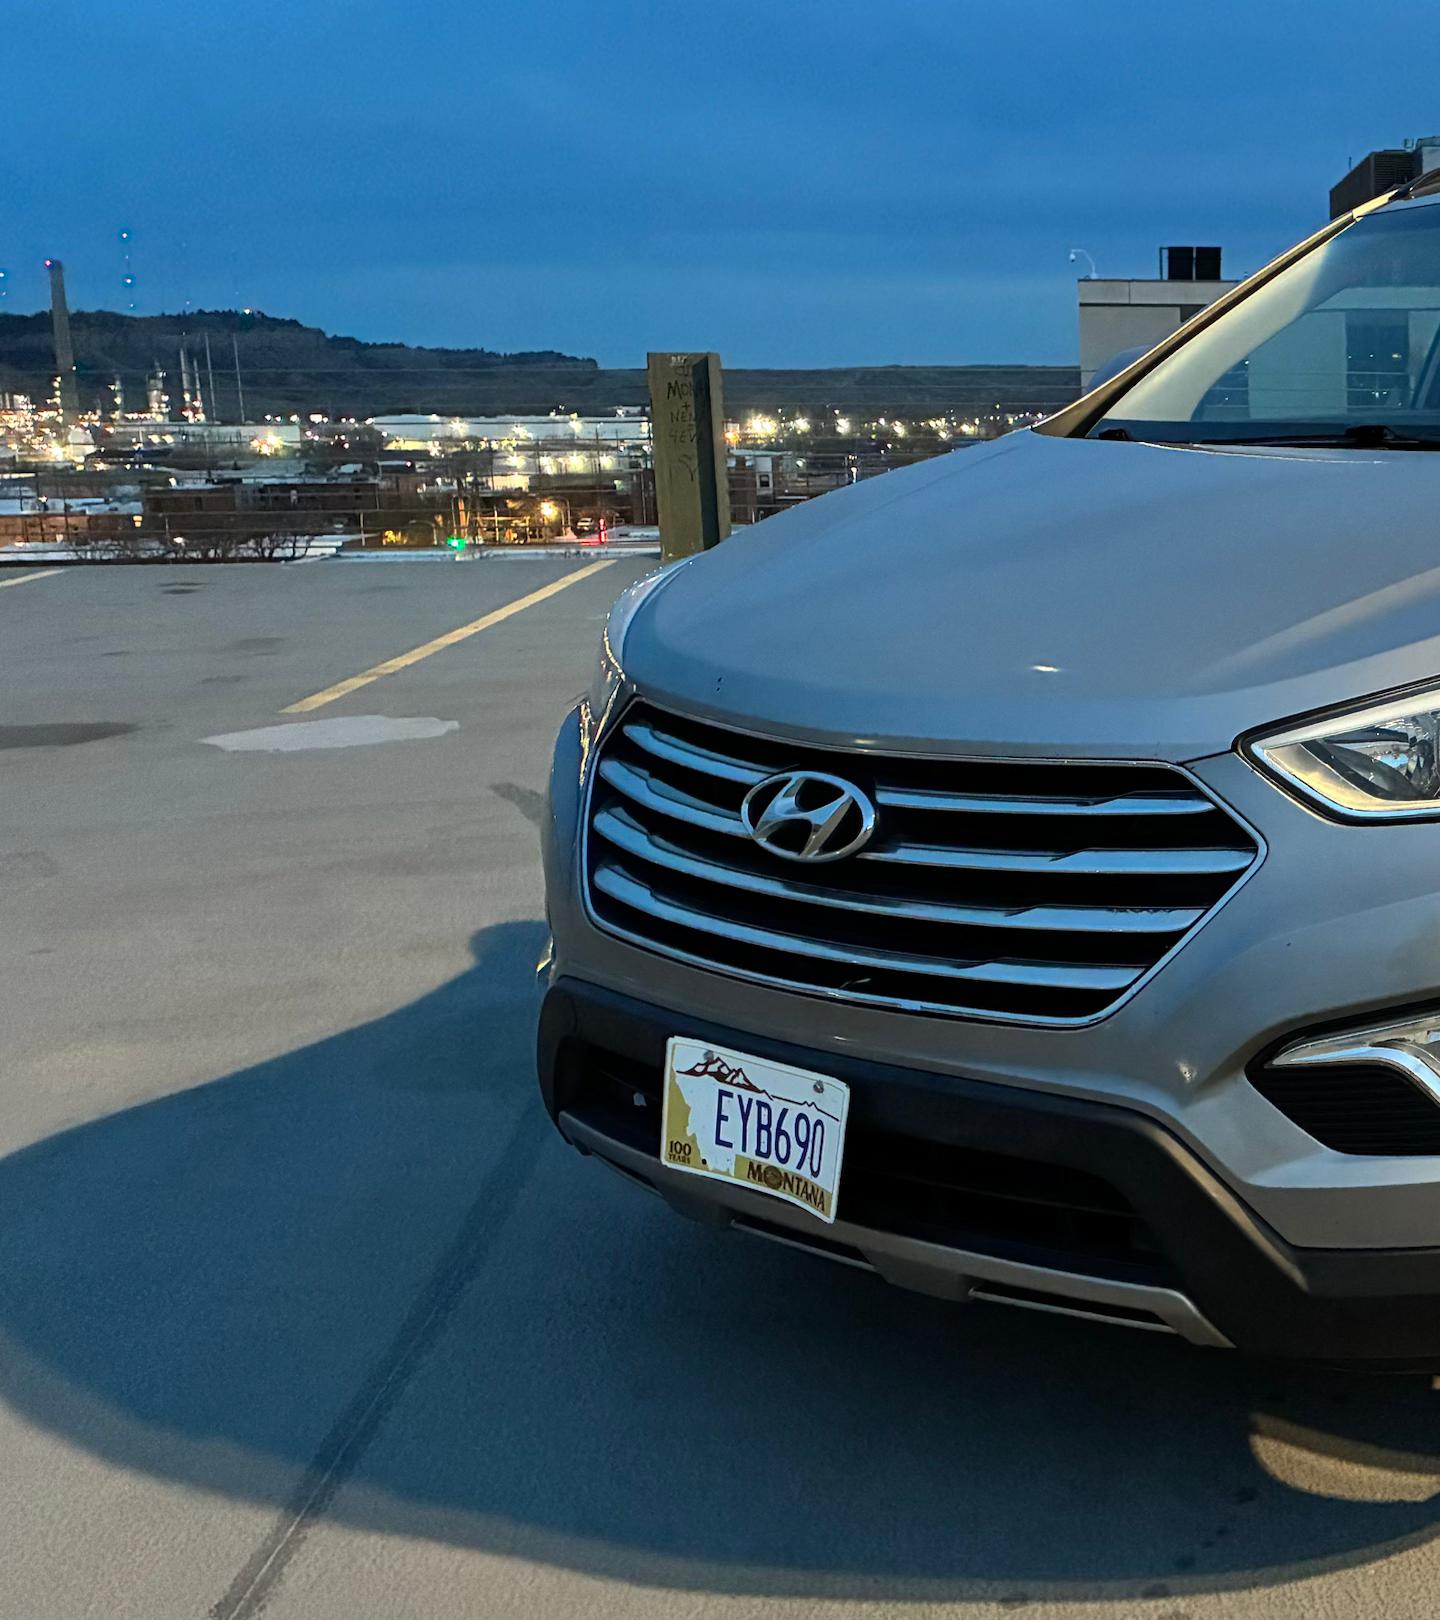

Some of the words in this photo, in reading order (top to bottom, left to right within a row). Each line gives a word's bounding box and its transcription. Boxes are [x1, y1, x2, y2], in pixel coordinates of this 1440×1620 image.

[669, 1140, 692, 1156] 100
[714, 1088, 825, 1178] EYB690
[747, 1161, 825, 1212] MONTANA
